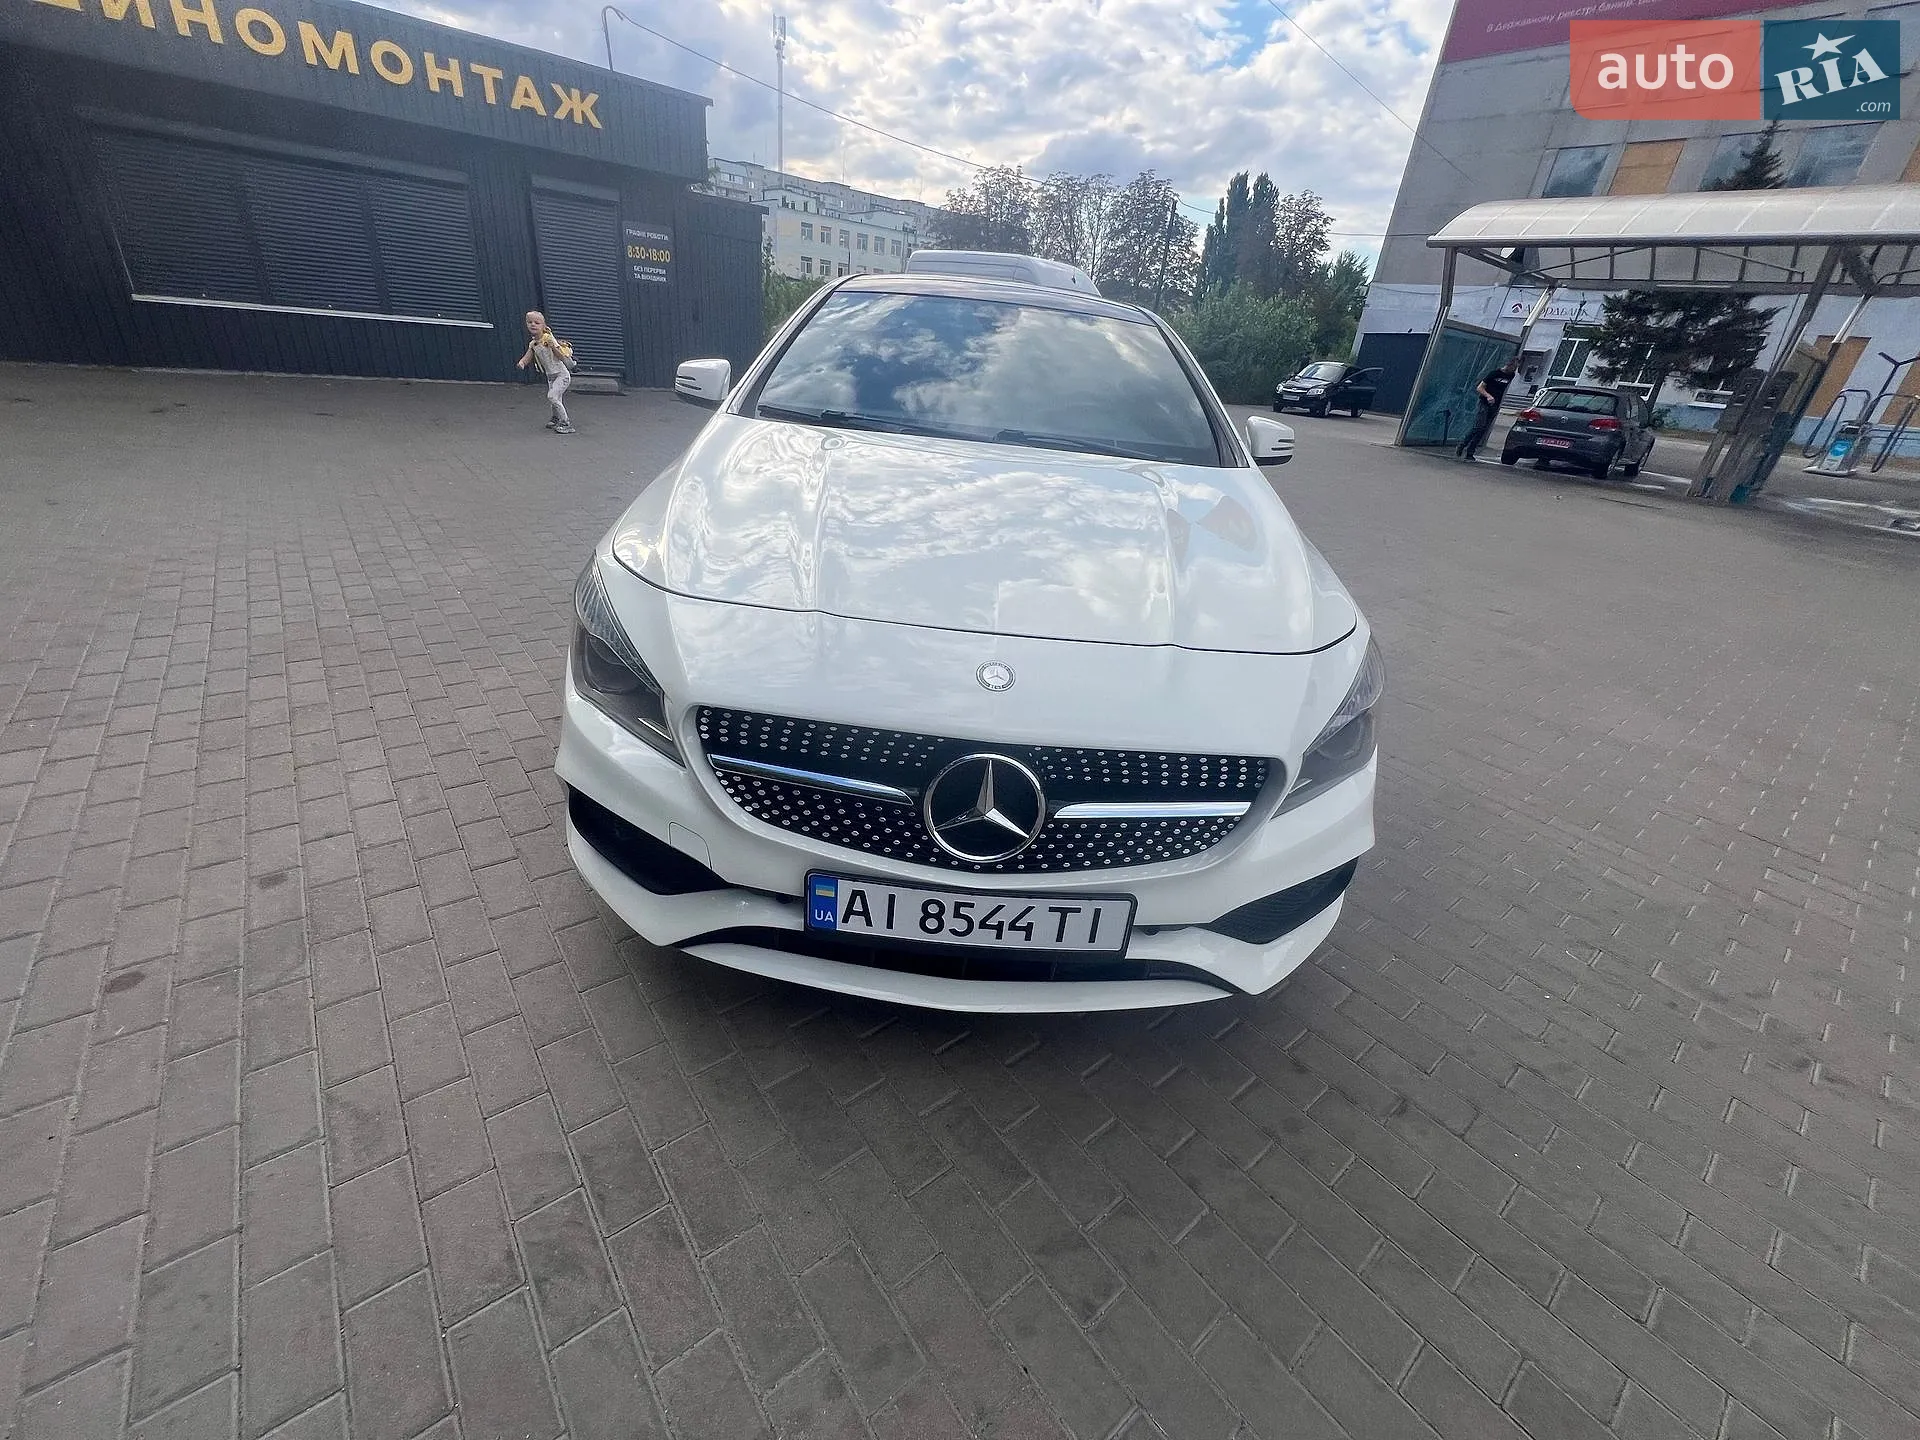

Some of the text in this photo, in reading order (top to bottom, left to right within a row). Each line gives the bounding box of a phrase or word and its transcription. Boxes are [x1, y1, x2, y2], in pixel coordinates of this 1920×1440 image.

[33, 0, 603, 129] ИНОМОНТАЖ
[627, 245, 670, 262] 8:30-18:00
[814, 908, 834, 923] UA
[841, 889, 1102, 944] AI 8544 TI
